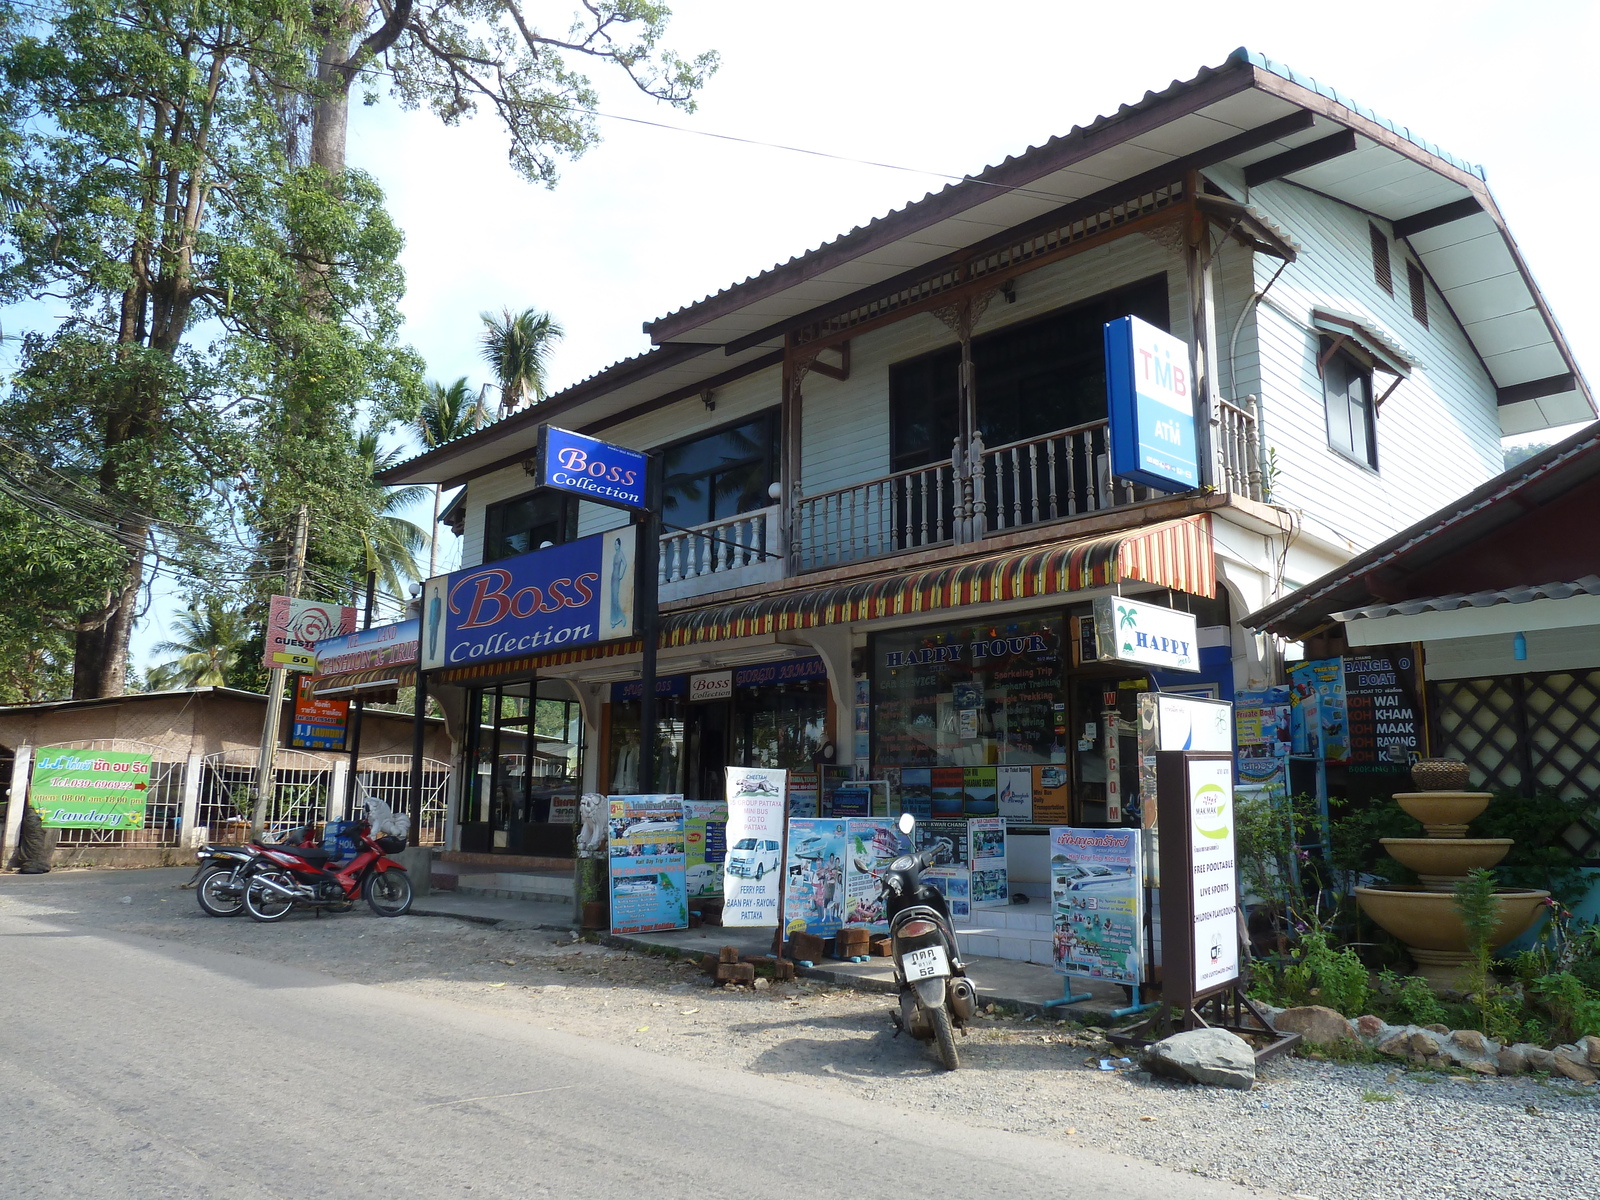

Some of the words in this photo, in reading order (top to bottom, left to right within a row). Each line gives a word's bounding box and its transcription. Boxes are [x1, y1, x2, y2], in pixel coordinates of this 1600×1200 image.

[1139, 344, 1186, 397] TMB
[1154, 420, 1181, 447] ATM
[552, 472, 640, 503] Collection
[450, 623, 593, 663] Collection
[1135, 631, 1190, 656] HAPPY
[320, 649, 373, 676] FASHION
[388, 639, 419, 664] TRIP
[885, 643, 963, 668] HAPPY
[970, 635, 1048, 659] TOUR
[1344, 657, 1411, 673] BANGBO
[736, 667, 775, 687] GIORGIO
[1036, 667, 1053, 676] Trip
[1028, 679, 1062, 689] Trekking
[1358, 673, 1397, 687] BOAT
[623, 683, 643, 696] HUG
[656, 681, 672, 692] OSS
[692, 690, 731, 699] Collection
[1019, 692, 1053, 702] Trekking
[1374, 695, 1399, 707] WAI
[1236, 710, 1258, 718] Private
[1375, 708, 1414, 720] KHAM
[1021, 717, 1046, 728] Diving
[1376, 722, 1414, 734] MAAK
[311, 727, 345, 739] LAUNDRY
[1024, 731, 1041, 741] Trip
[93, 759, 111, 772] ซัก
[112, 762, 130, 772] อบ
[132, 761, 149, 773] รีด
[1349, 765, 1389, 773] BOOKING
[1194, 864, 1206, 875] FREE
[1206, 859, 1234, 873] POOLTABLE
[740, 885, 755, 894] FERRY
[755, 885, 766, 894] PIER
[1200, 886, 1211, 897] LIVE
[1211, 883, 1229, 895] SPORTS
[726, 898, 741, 908] BAAN
[742, 898, 753, 908] PAY
[1088, 897, 1099, 910] 3
[740, 911, 763, 920] PATTAYA
[1194, 912, 1213, 924] CHILDREN
[1212, 905, 1237, 919] PLAYGROUND
[919, 966, 935, 976] 52
